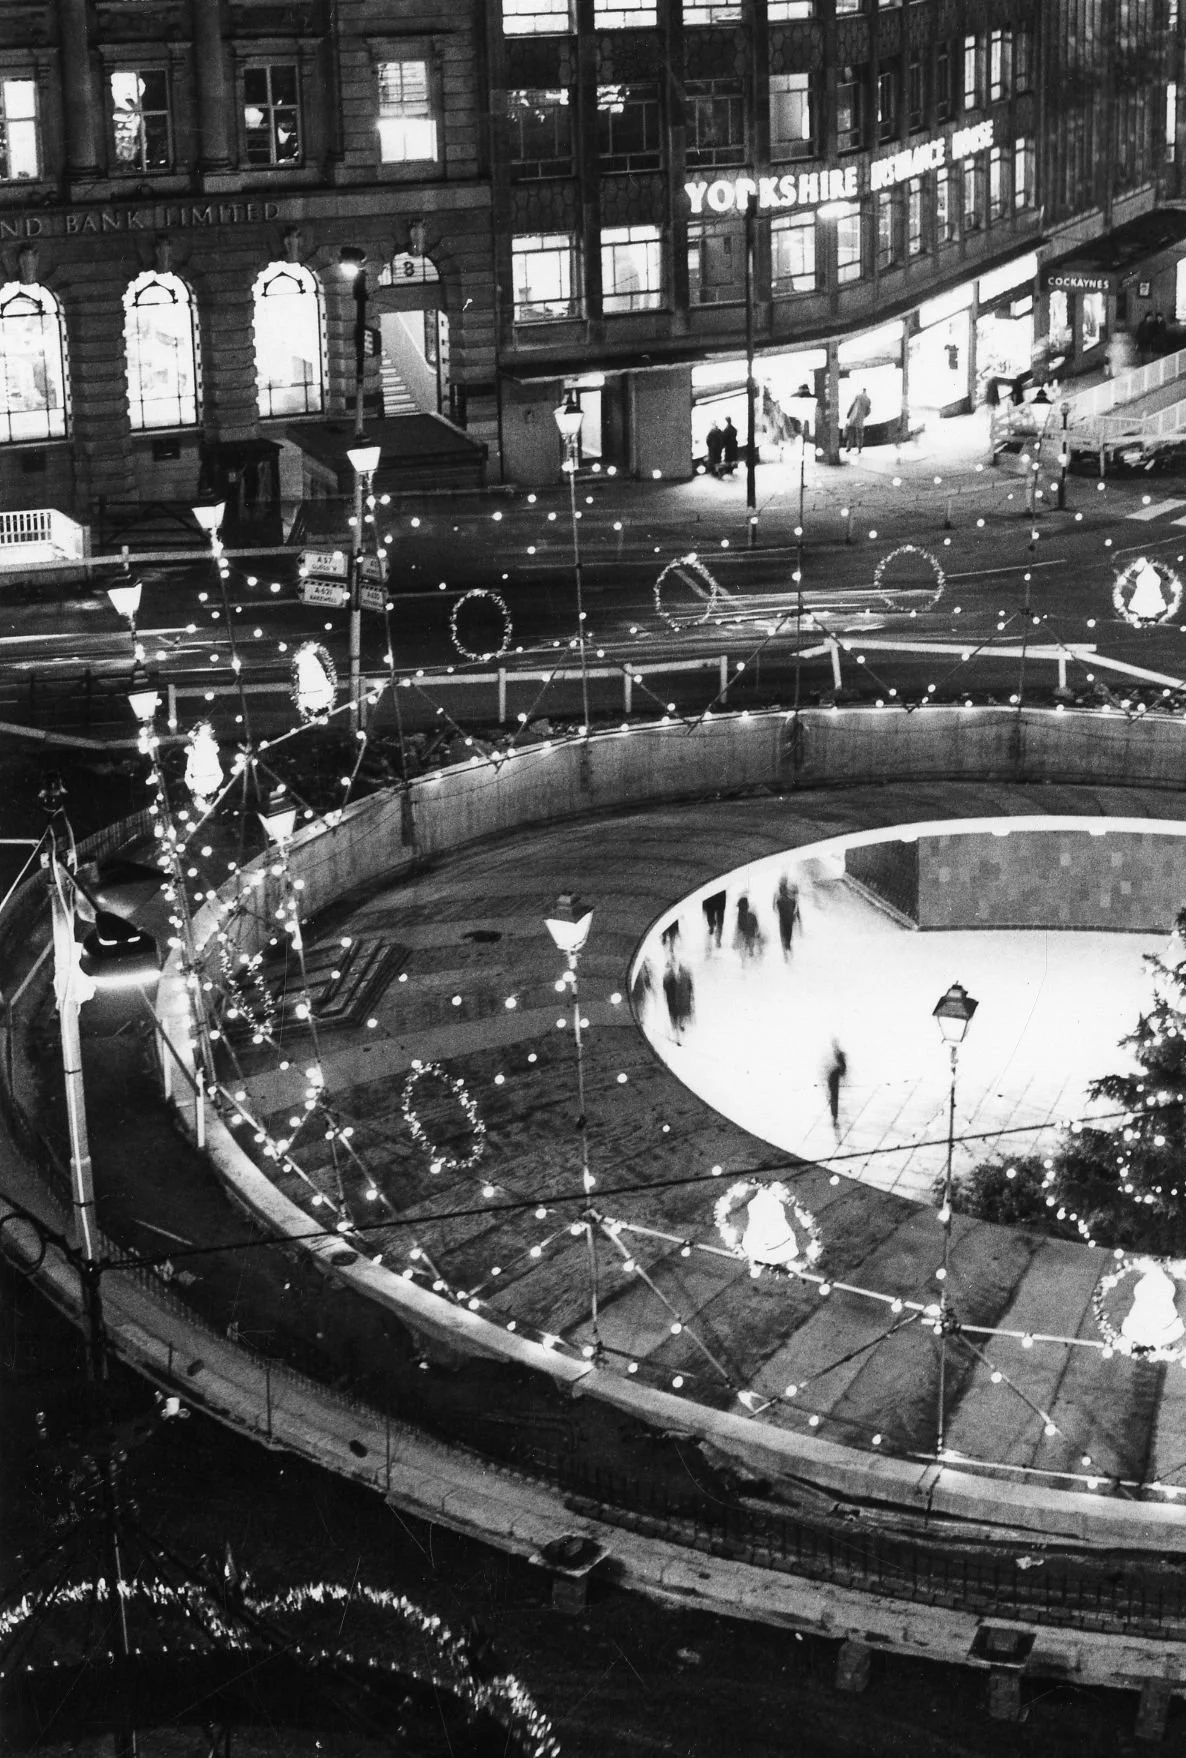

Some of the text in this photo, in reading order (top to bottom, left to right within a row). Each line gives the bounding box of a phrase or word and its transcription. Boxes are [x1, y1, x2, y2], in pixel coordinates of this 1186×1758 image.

[684, 166, 858, 213] YORKSHIRE
[66, 210, 144, 234] BANK
[165, 202, 280, 228] LIMITED
[1047, 277, 1109, 289] COCKAYNES
